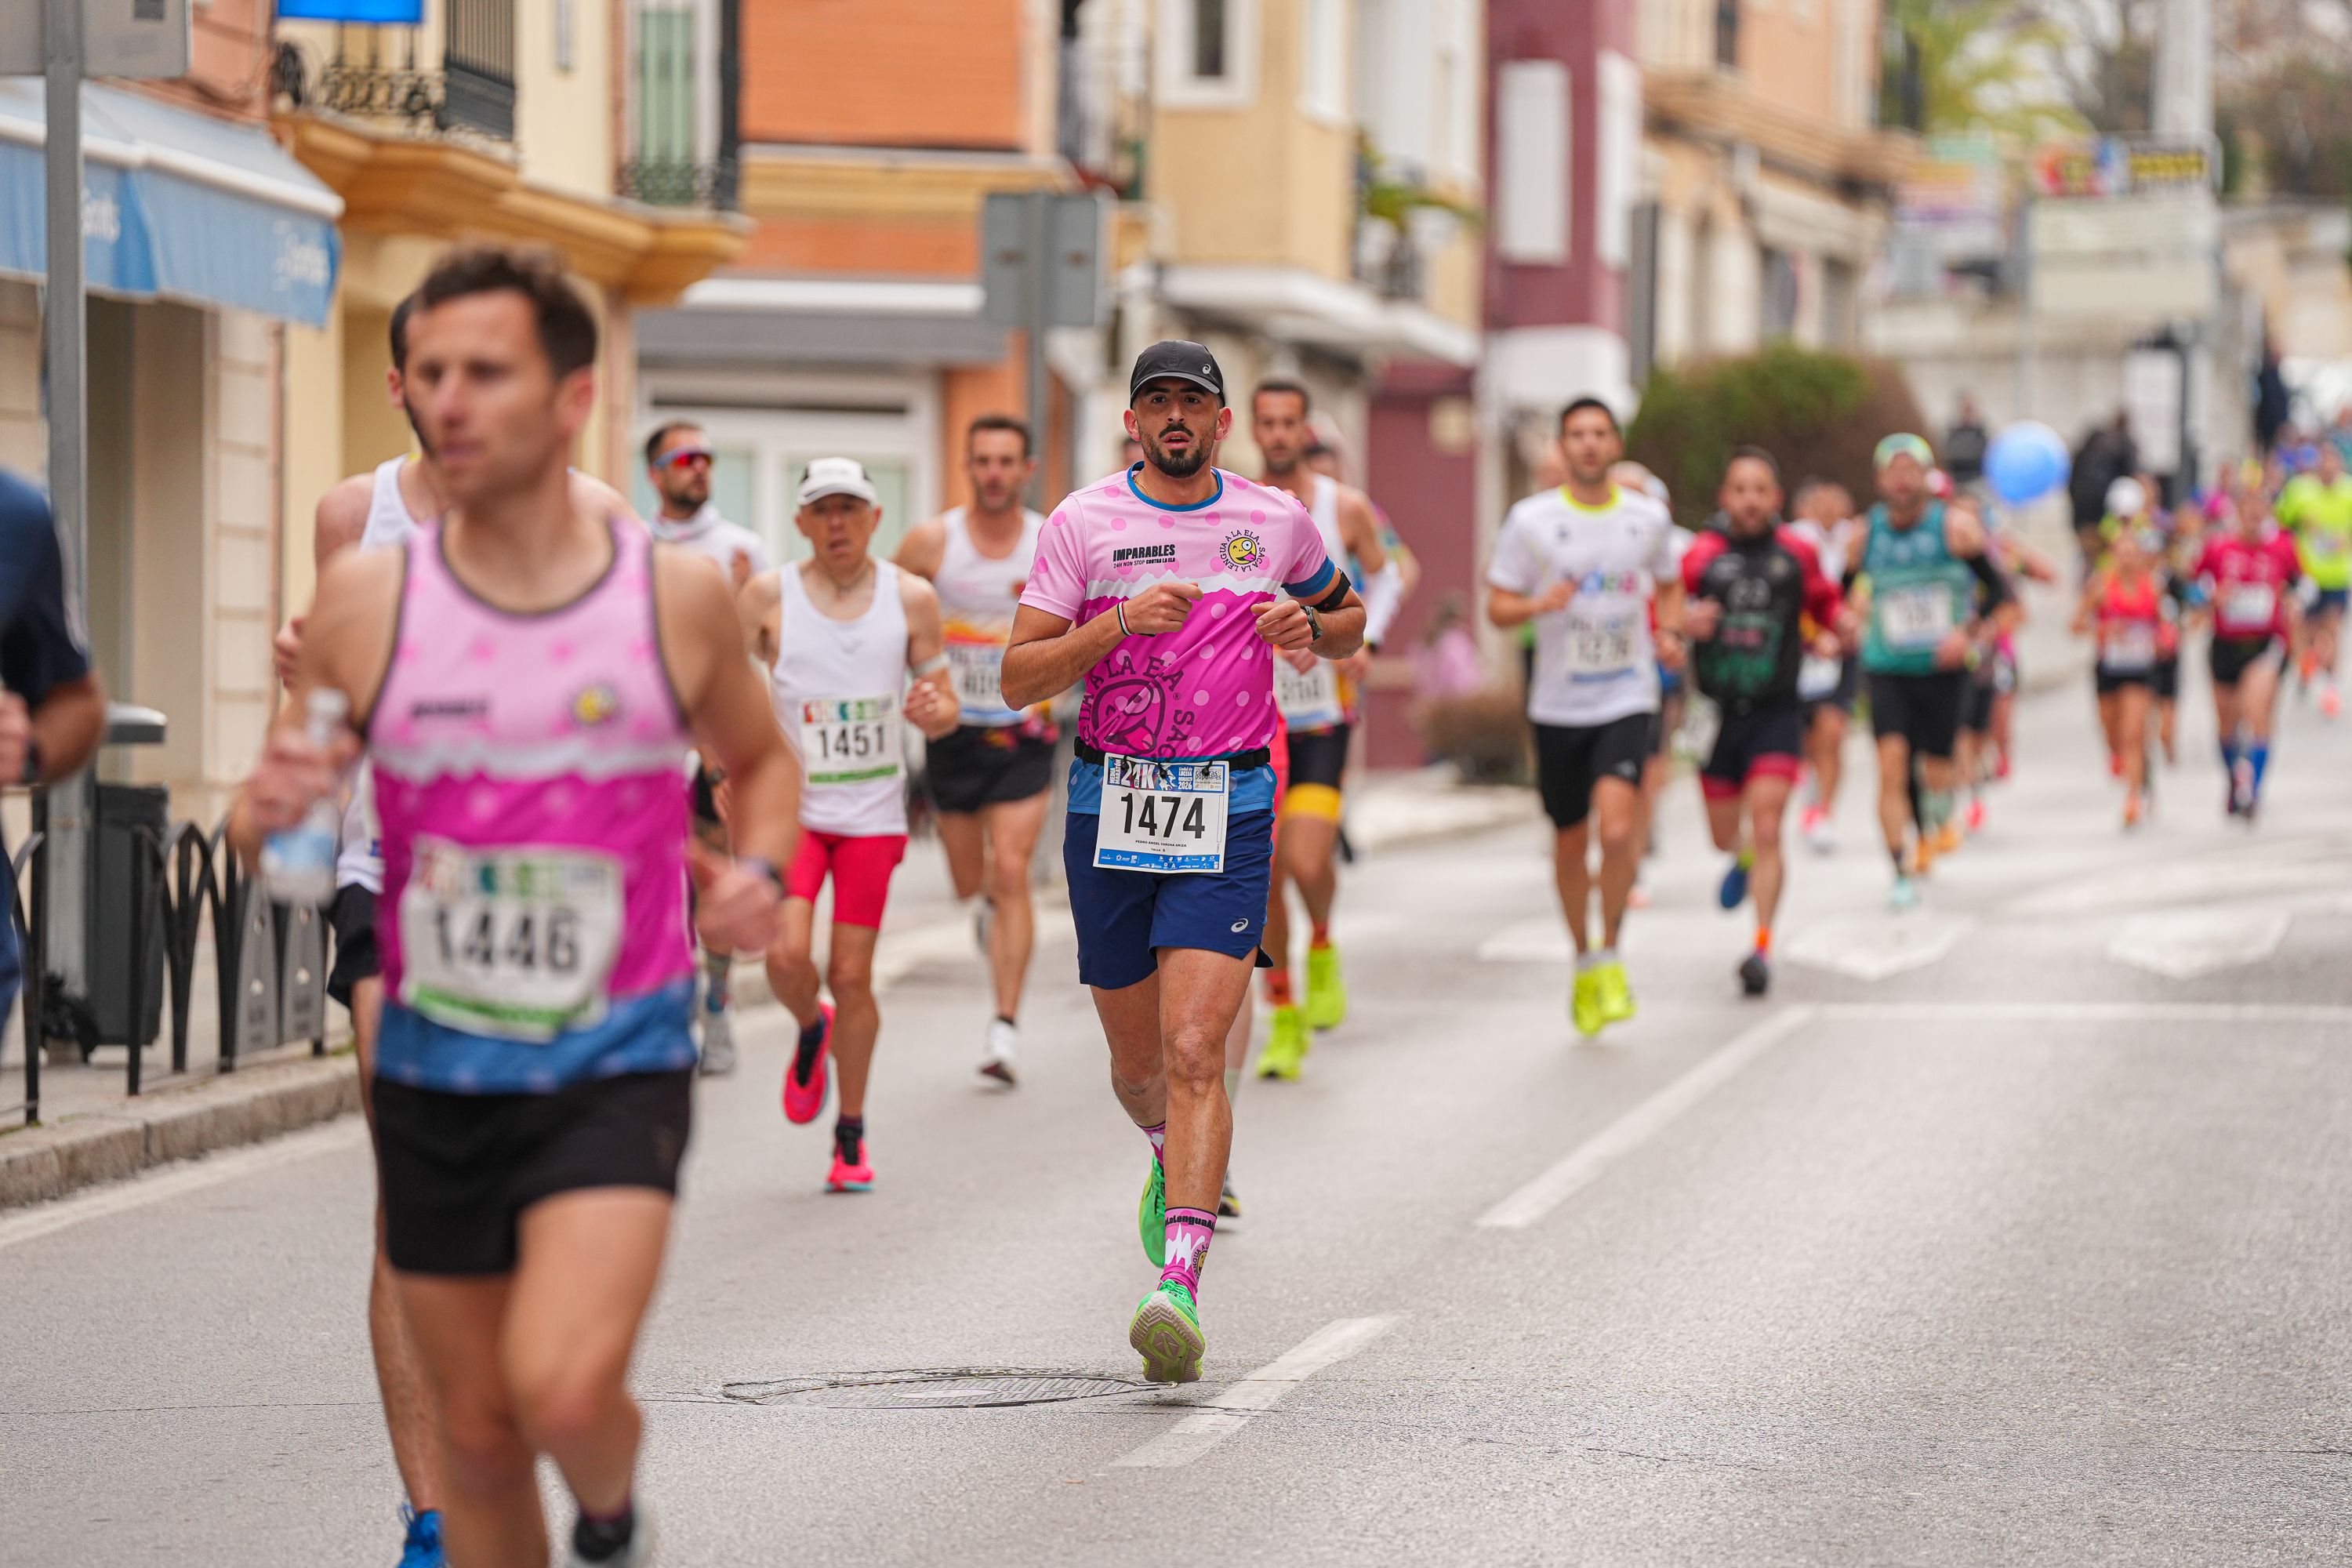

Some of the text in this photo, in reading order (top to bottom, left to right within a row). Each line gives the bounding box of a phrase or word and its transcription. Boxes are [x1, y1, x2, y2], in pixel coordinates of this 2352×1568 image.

[1112, 544, 1175, 561] IMPARABLES
[1220, 543, 1240, 572] LENGUA
[1252, 546, 1265, 568] SACA
[1104, 655, 1136, 678] LA
[1142, 655, 1185, 692] EA
[1090, 675, 1105, 691] A
[817, 724, 885, 759] 1451
[1150, 709, 1195, 762] SAC
[1121, 760, 1156, 789] 21K
[1178, 781, 1192, 789] 2026
[1121, 793, 1205, 839] 1474
[435, 907, 580, 971] 1446
